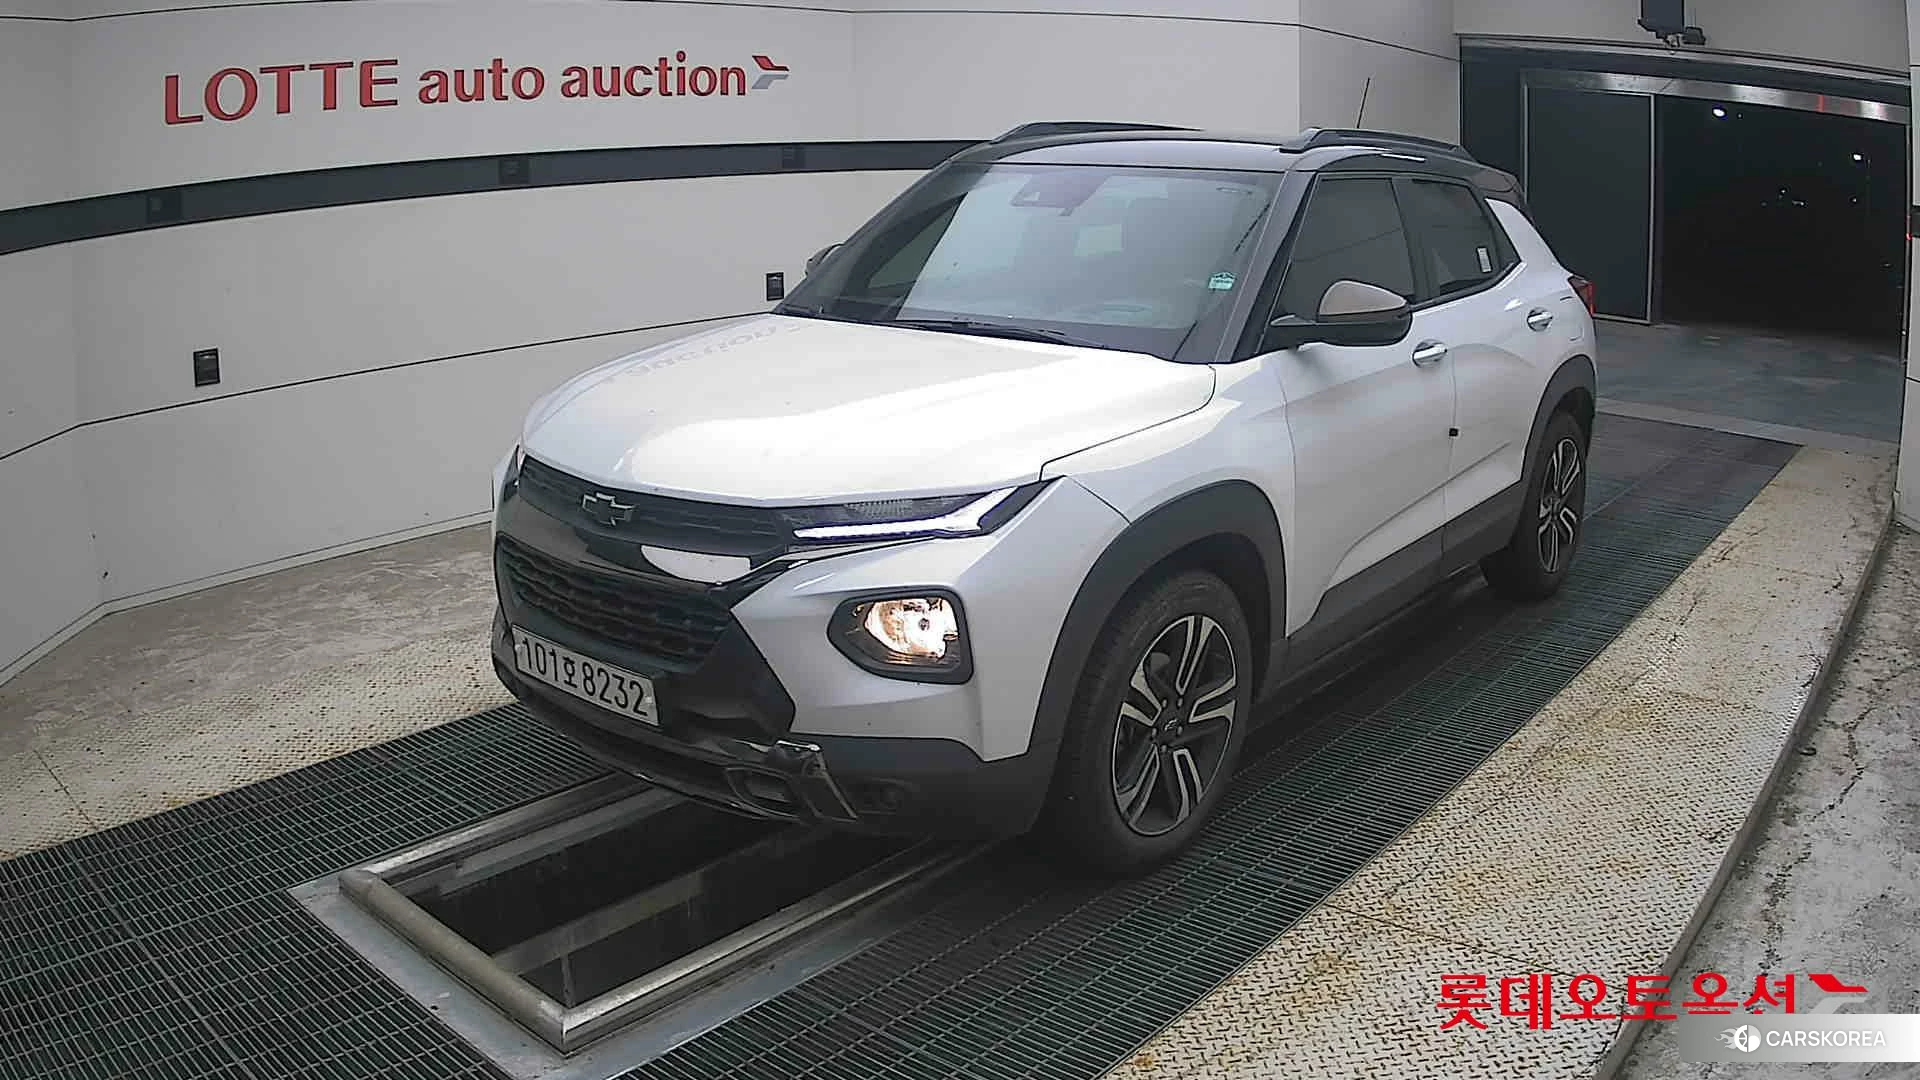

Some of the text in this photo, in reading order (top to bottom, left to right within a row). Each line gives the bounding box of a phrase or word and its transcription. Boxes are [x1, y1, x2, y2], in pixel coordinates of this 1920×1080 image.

[164, 50, 747, 125] LOTTE auto auction
